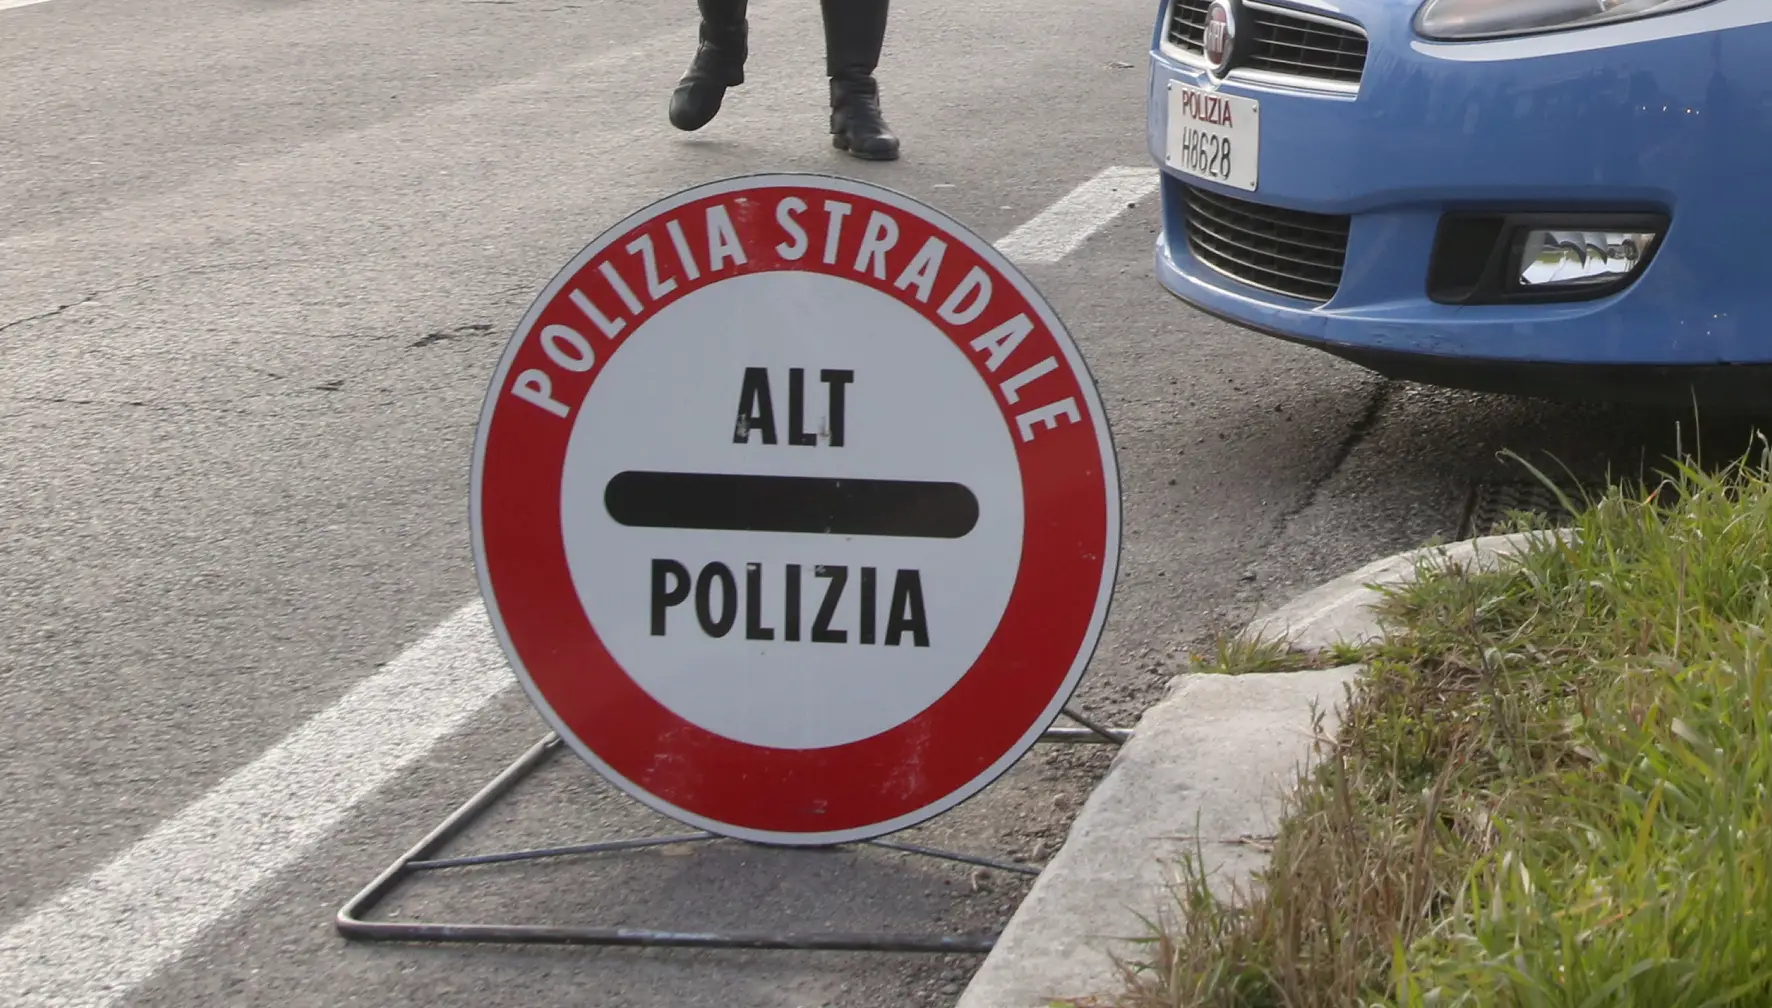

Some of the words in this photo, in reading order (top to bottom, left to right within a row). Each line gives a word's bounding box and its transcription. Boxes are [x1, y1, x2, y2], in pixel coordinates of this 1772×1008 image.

[1207, 19, 1227, 53] FIAT
[1182, 89, 1233, 128] POLIZIA
[1181, 126, 1232, 180] H8628
[510, 204, 748, 418] POLIZIA
[774, 196, 1082, 442] STRADALE
[732, 366, 855, 448] ALT
[649, 558, 931, 648] POLIZIA
